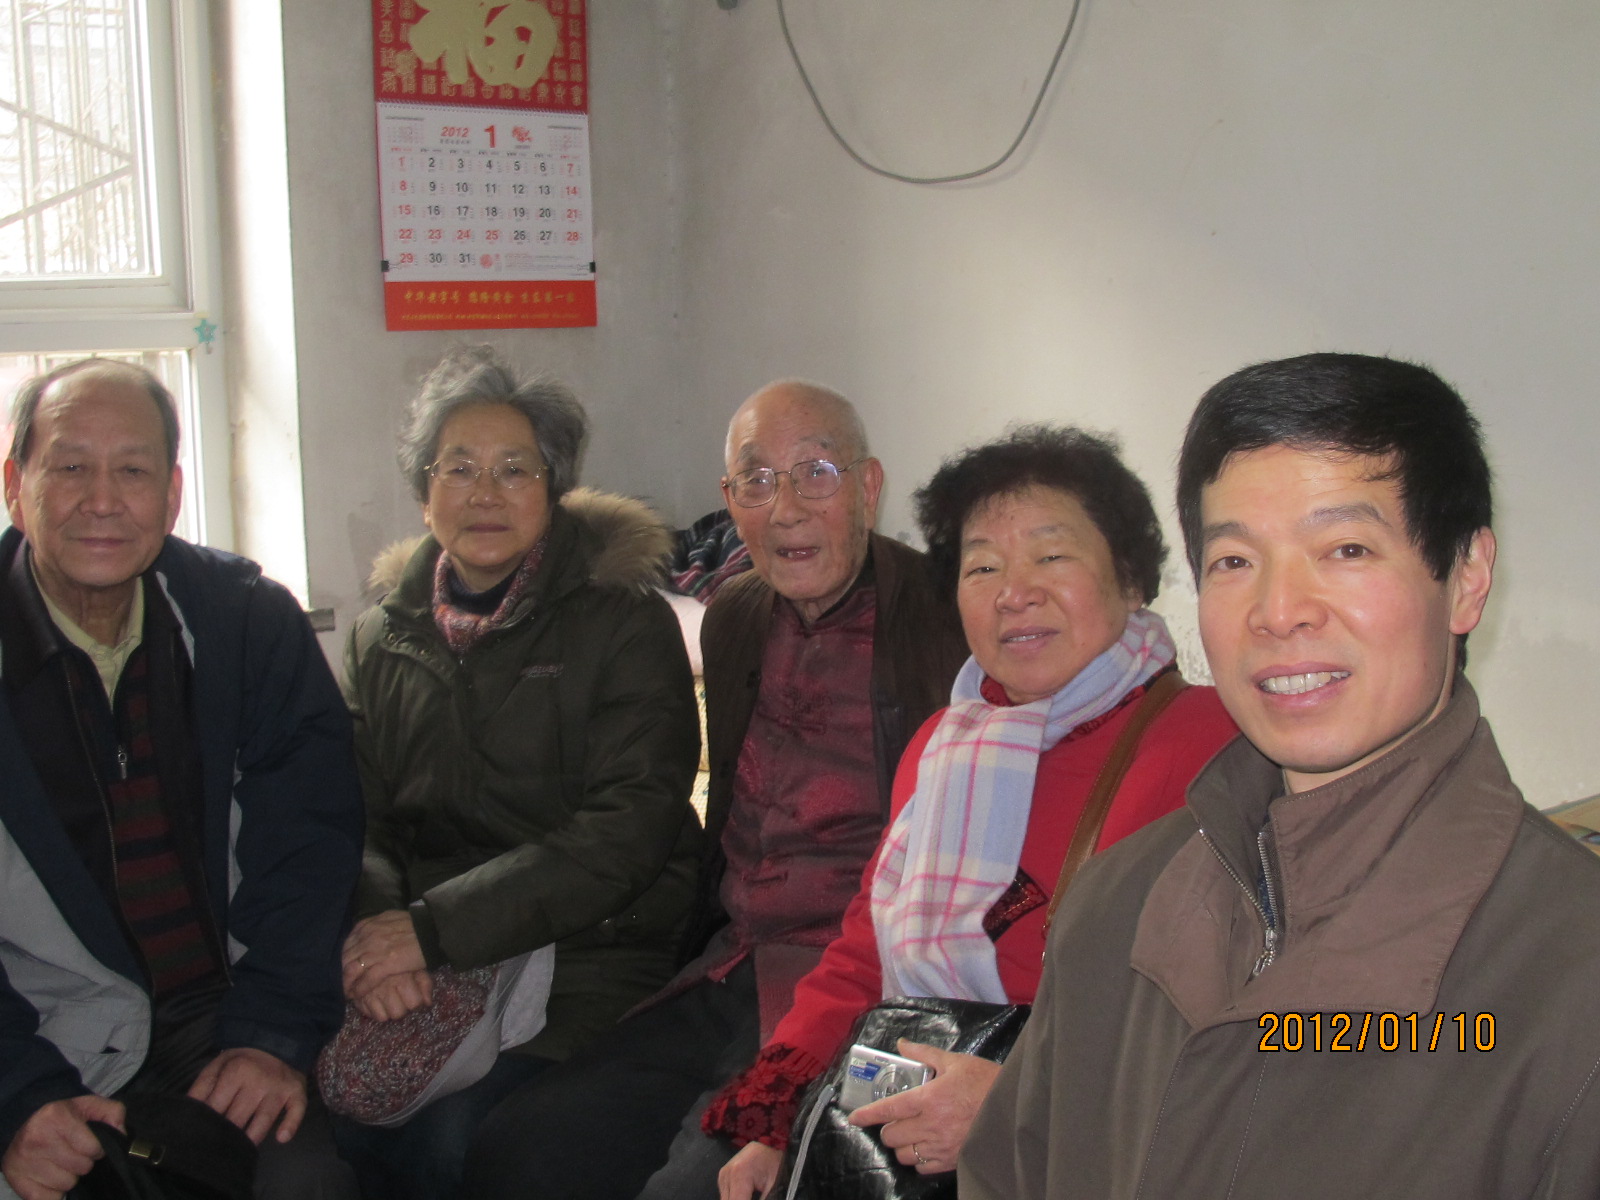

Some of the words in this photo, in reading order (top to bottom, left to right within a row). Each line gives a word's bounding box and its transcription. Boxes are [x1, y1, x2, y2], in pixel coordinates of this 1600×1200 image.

[440, 126, 469, 137] 2012
[484, 125, 496, 148] 1
[398, 157, 405, 167] 1
[428, 157, 435, 168] 2
[457, 158, 464, 169] 3
[486, 159, 493, 170] 4
[514, 161, 521, 171] 5
[539, 162, 546, 172] 6
[567, 163, 574, 174] 7
[399, 180, 407, 190] 8
[429, 182, 436, 192] 9
[455, 182, 469, 193] 10
[485, 183, 497, 193] 11
[512, 184, 525, 195] 12
[538, 185, 551, 195] 13
[565, 186, 578, 196] 14
[398, 205, 412, 215] 15
[427, 205, 441, 216] 16
[456, 206, 469, 217] 17
[485, 206, 498, 217] 18
[513, 207, 526, 218] 19
[539, 208, 551, 219] 20
[566, 209, 578, 219] 21
[399, 229, 412, 240] 22
[428, 229, 442, 240] 23
[457, 229, 470, 240] 24
[485, 230, 499, 241] 25
[513, 230, 526, 241] 26
[539, 231, 552, 241] 27
[566, 231, 579, 242] 28
[400, 253, 414, 264] 29
[429, 253, 443, 264] 30
[458, 253, 471, 264] 31
